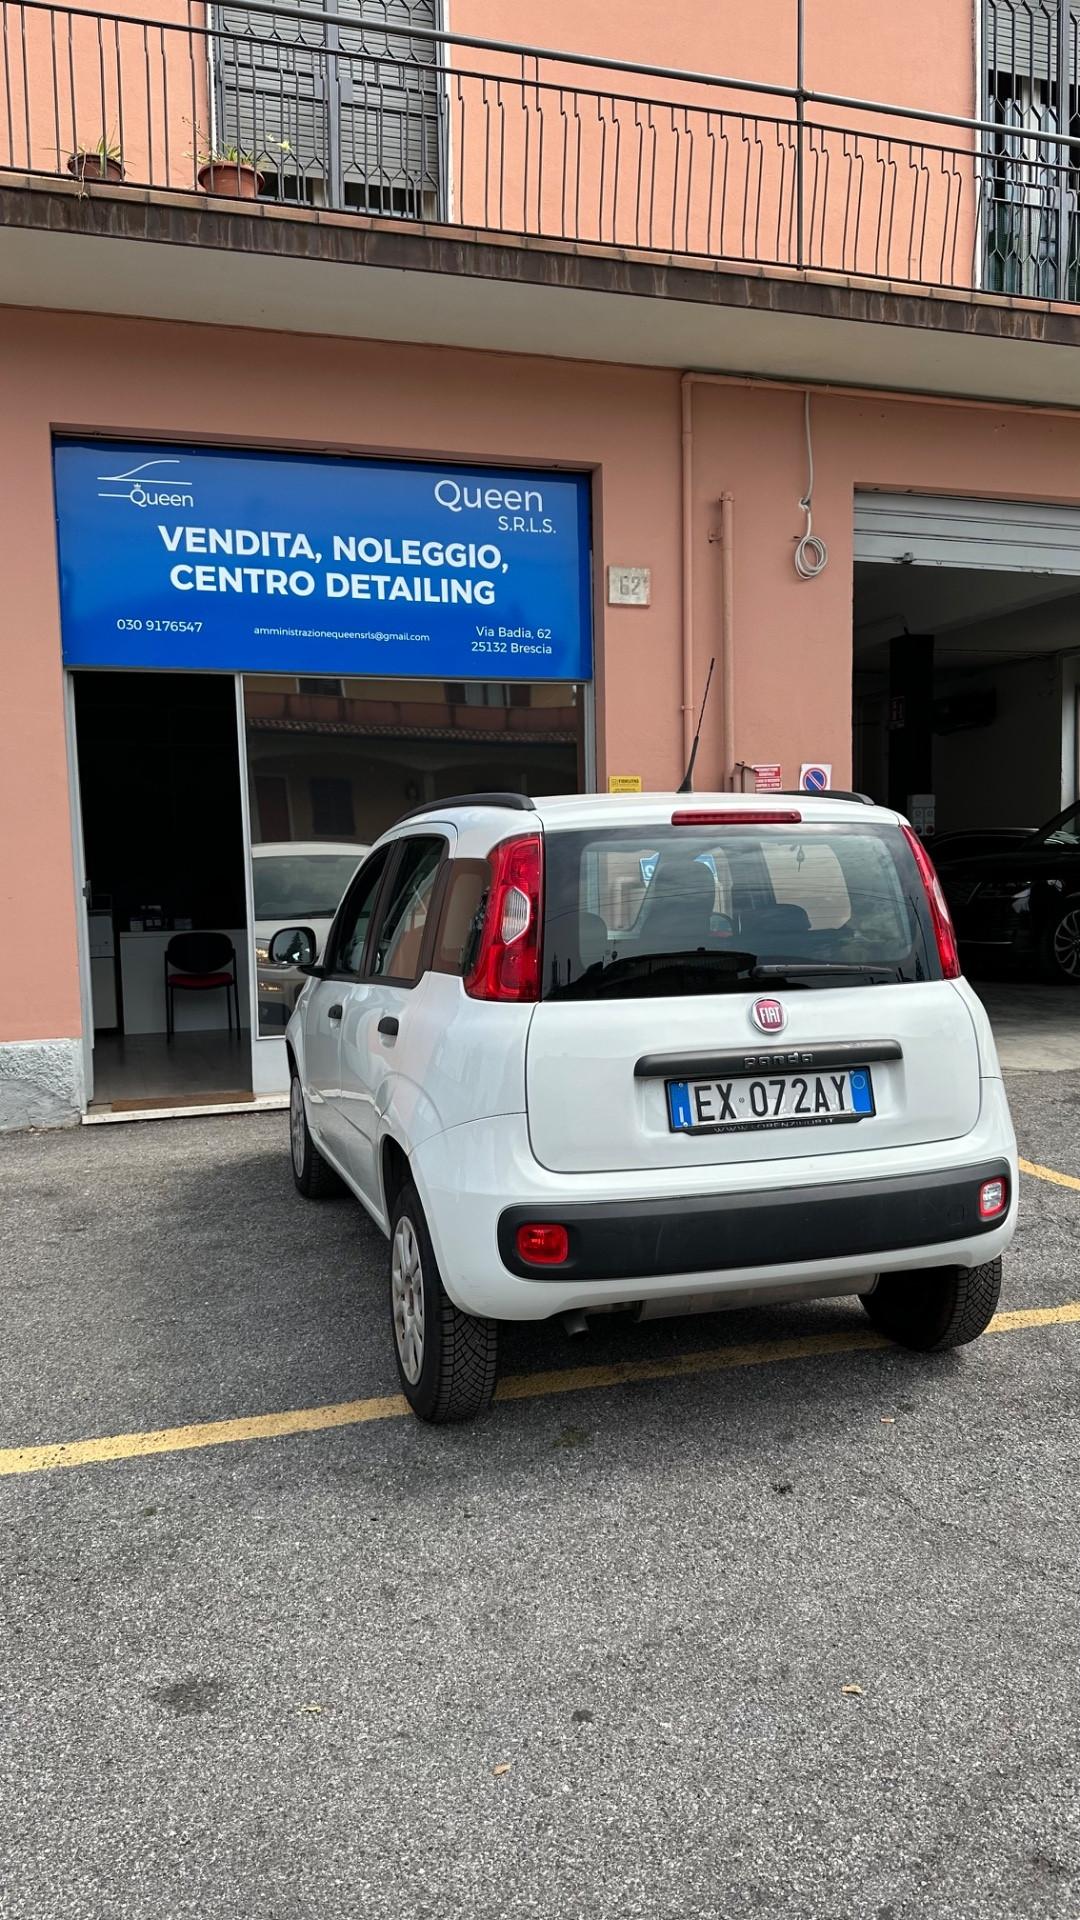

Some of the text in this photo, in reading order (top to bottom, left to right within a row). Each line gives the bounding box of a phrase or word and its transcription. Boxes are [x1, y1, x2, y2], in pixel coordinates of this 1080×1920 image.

[129, 487, 194, 507] Queen
[434, 480, 543, 512] Queen
[498, 515, 556, 534] S.R.L.S.
[158, 525, 509, 573] VENDITA, NOLEGGIO,
[170, 564, 495, 604] CENTRO DETAILING
[116, 618, 203, 633] 030 9176547
[253, 627, 430, 642] amministrazionequeensrls@gmail.com
[476, 625, 552, 640] Via Badia, 62
[471, 641, 552, 654] 25132 Brescia
[759, 1006, 781, 1024] FIAT
[743, 1052, 813, 1069] panda
[694, 1075, 846, 1121] EX 072AY
